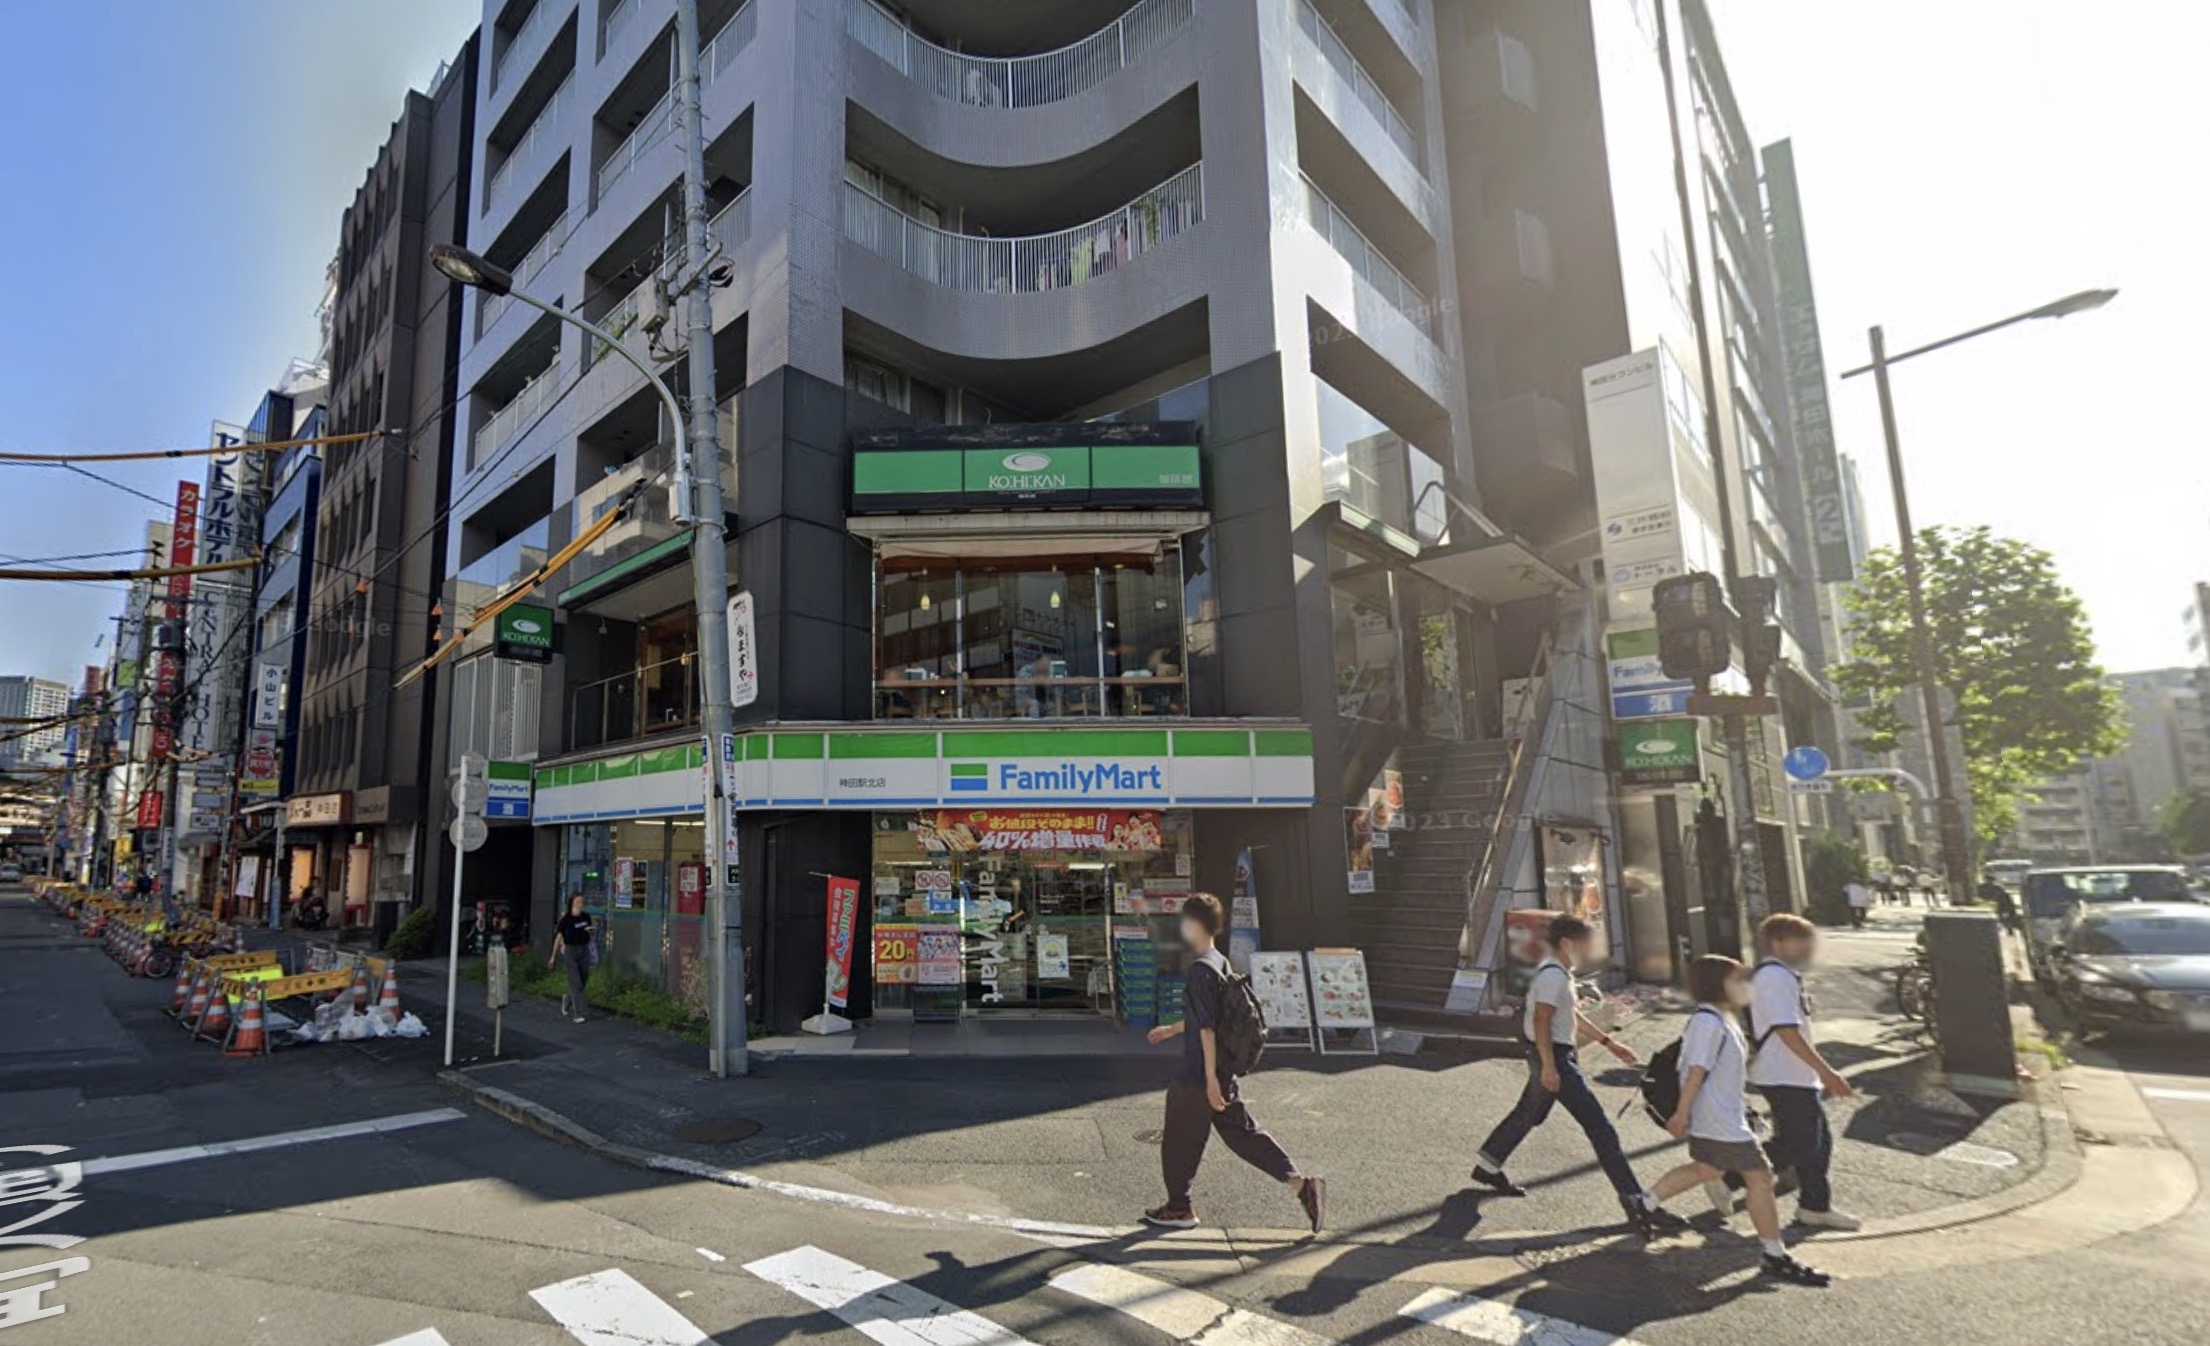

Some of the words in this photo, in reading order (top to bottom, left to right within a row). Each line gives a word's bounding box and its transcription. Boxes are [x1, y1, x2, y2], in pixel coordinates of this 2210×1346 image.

[175, 488, 198, 549] カラオケ
[489, 783, 528, 794] FamilyMart
[838, 777, 887, 789] 神田駅北店
[1000, 763, 1162, 793] FamilyMart
